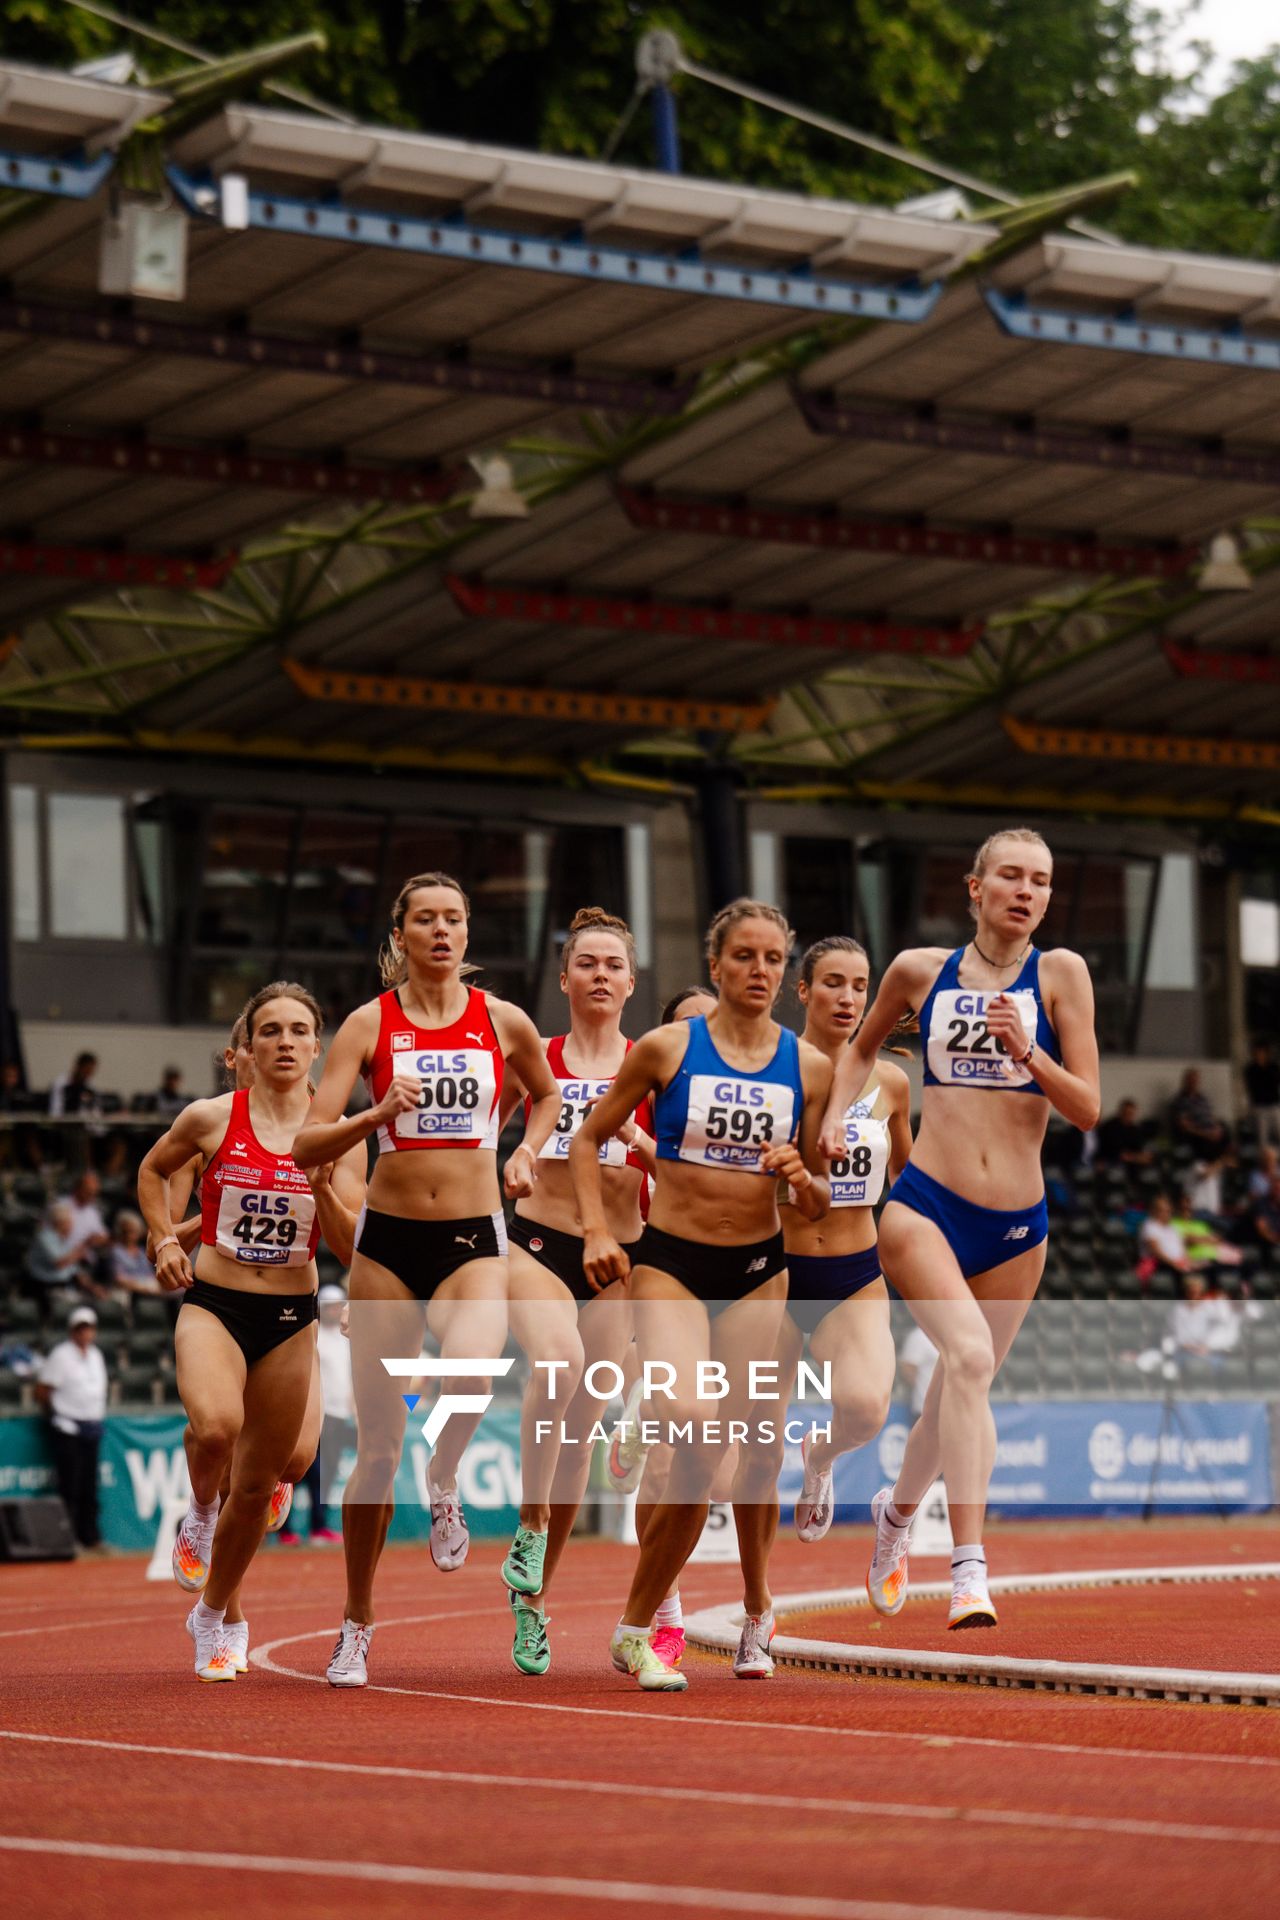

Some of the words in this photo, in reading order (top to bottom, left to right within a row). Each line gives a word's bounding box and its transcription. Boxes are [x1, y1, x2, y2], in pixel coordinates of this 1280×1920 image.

[955, 995, 1001, 1016] GL
[415, 1077, 479, 1109] 508
[441, 1115, 471, 1126] PLAN
[705, 1106, 774, 1145] 593
[834, 1184, 864, 1194] PLAN
[232, 1214, 297, 1247] 429
[258, 1250, 288, 1259] PLAN
[708, 1503, 728, 1530] 5
[926, 1497, 946, 1523] 4
